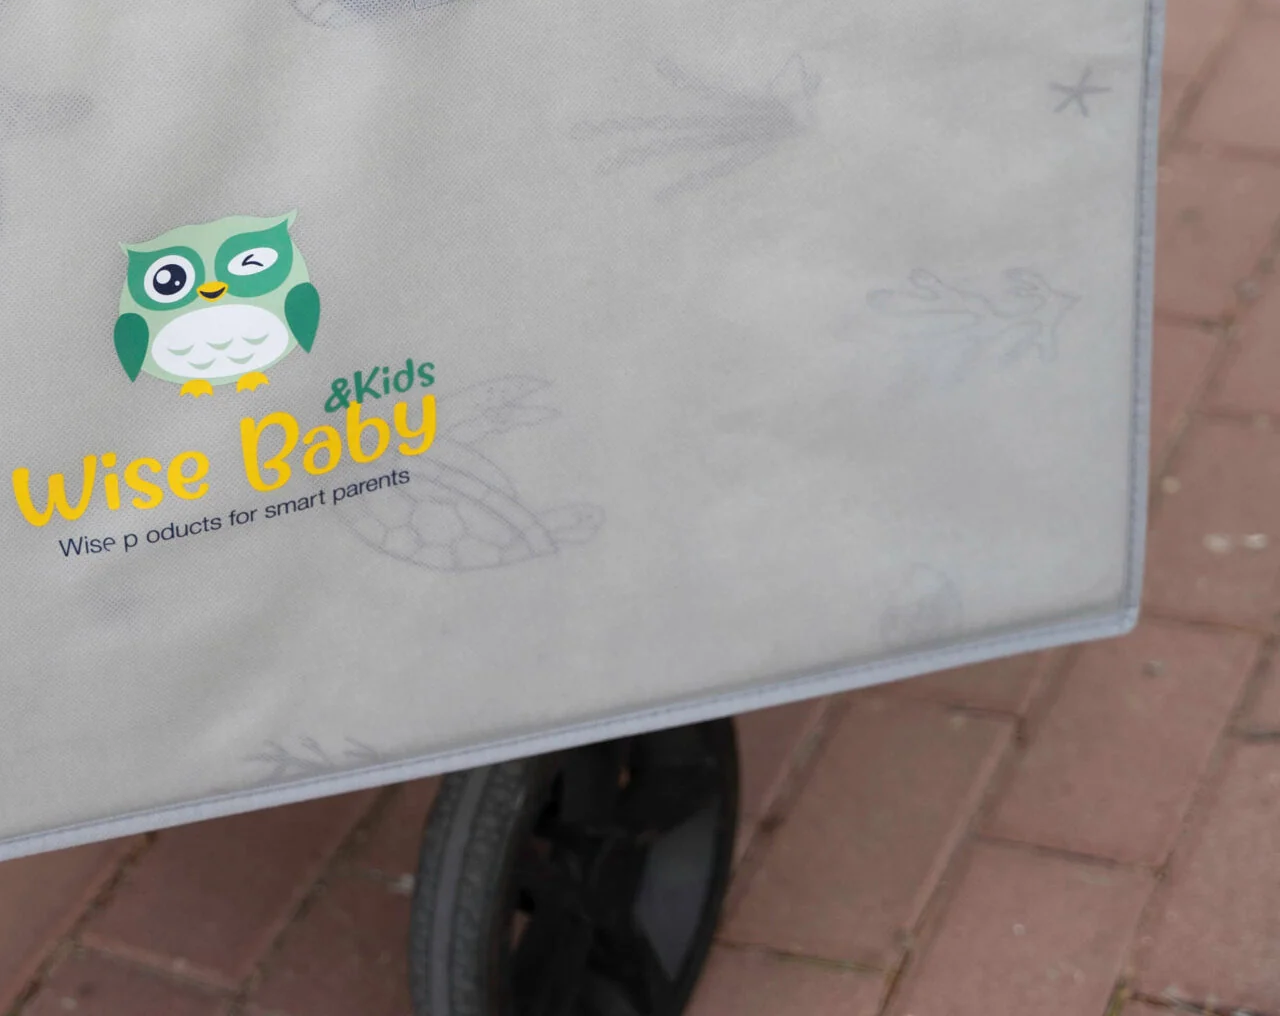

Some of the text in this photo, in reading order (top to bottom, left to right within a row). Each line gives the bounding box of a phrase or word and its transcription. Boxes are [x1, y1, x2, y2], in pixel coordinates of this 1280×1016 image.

[323, 358, 437, 414] &Kids
[11, 395, 438, 528] Wise Baby
[58, 536, 117, 557] Wise
[228, 507, 259, 528] for
[264, 489, 327, 520] smart
[332, 468, 411, 504] parents
